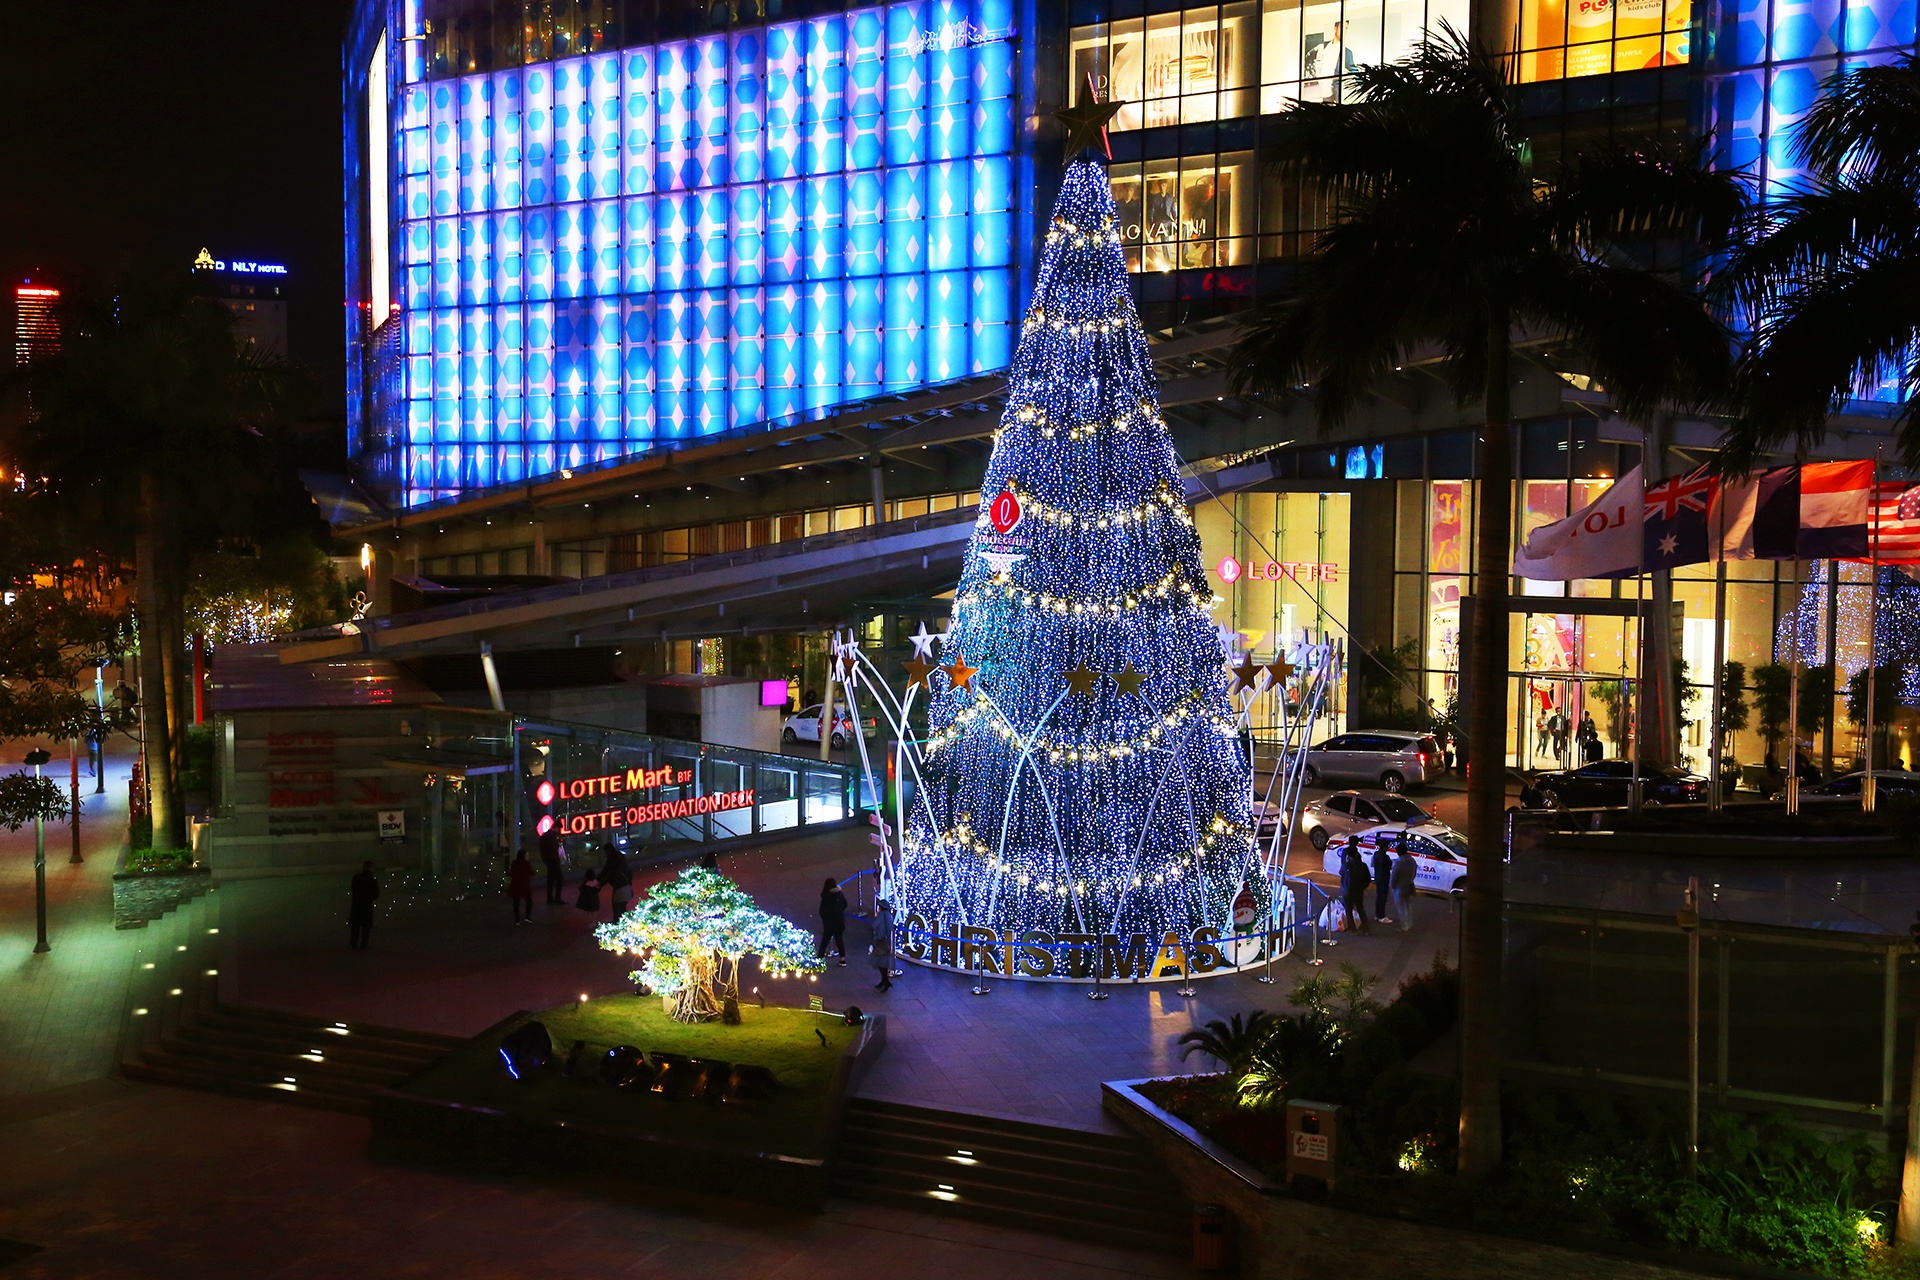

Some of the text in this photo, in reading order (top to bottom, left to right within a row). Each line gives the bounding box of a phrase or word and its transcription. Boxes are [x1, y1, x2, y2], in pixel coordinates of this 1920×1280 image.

[258, 264, 287, 274] HOTEL
[1247, 561, 1337, 583] LOTTE
[560, 764, 693, 800] LOTTE Mart B1F
[560, 789, 755, 835] LOTTE OBSERVATION DECK
[1422, 865, 1437, 874] 3A
[904, 914, 1221, 979] CHRISTMAS
